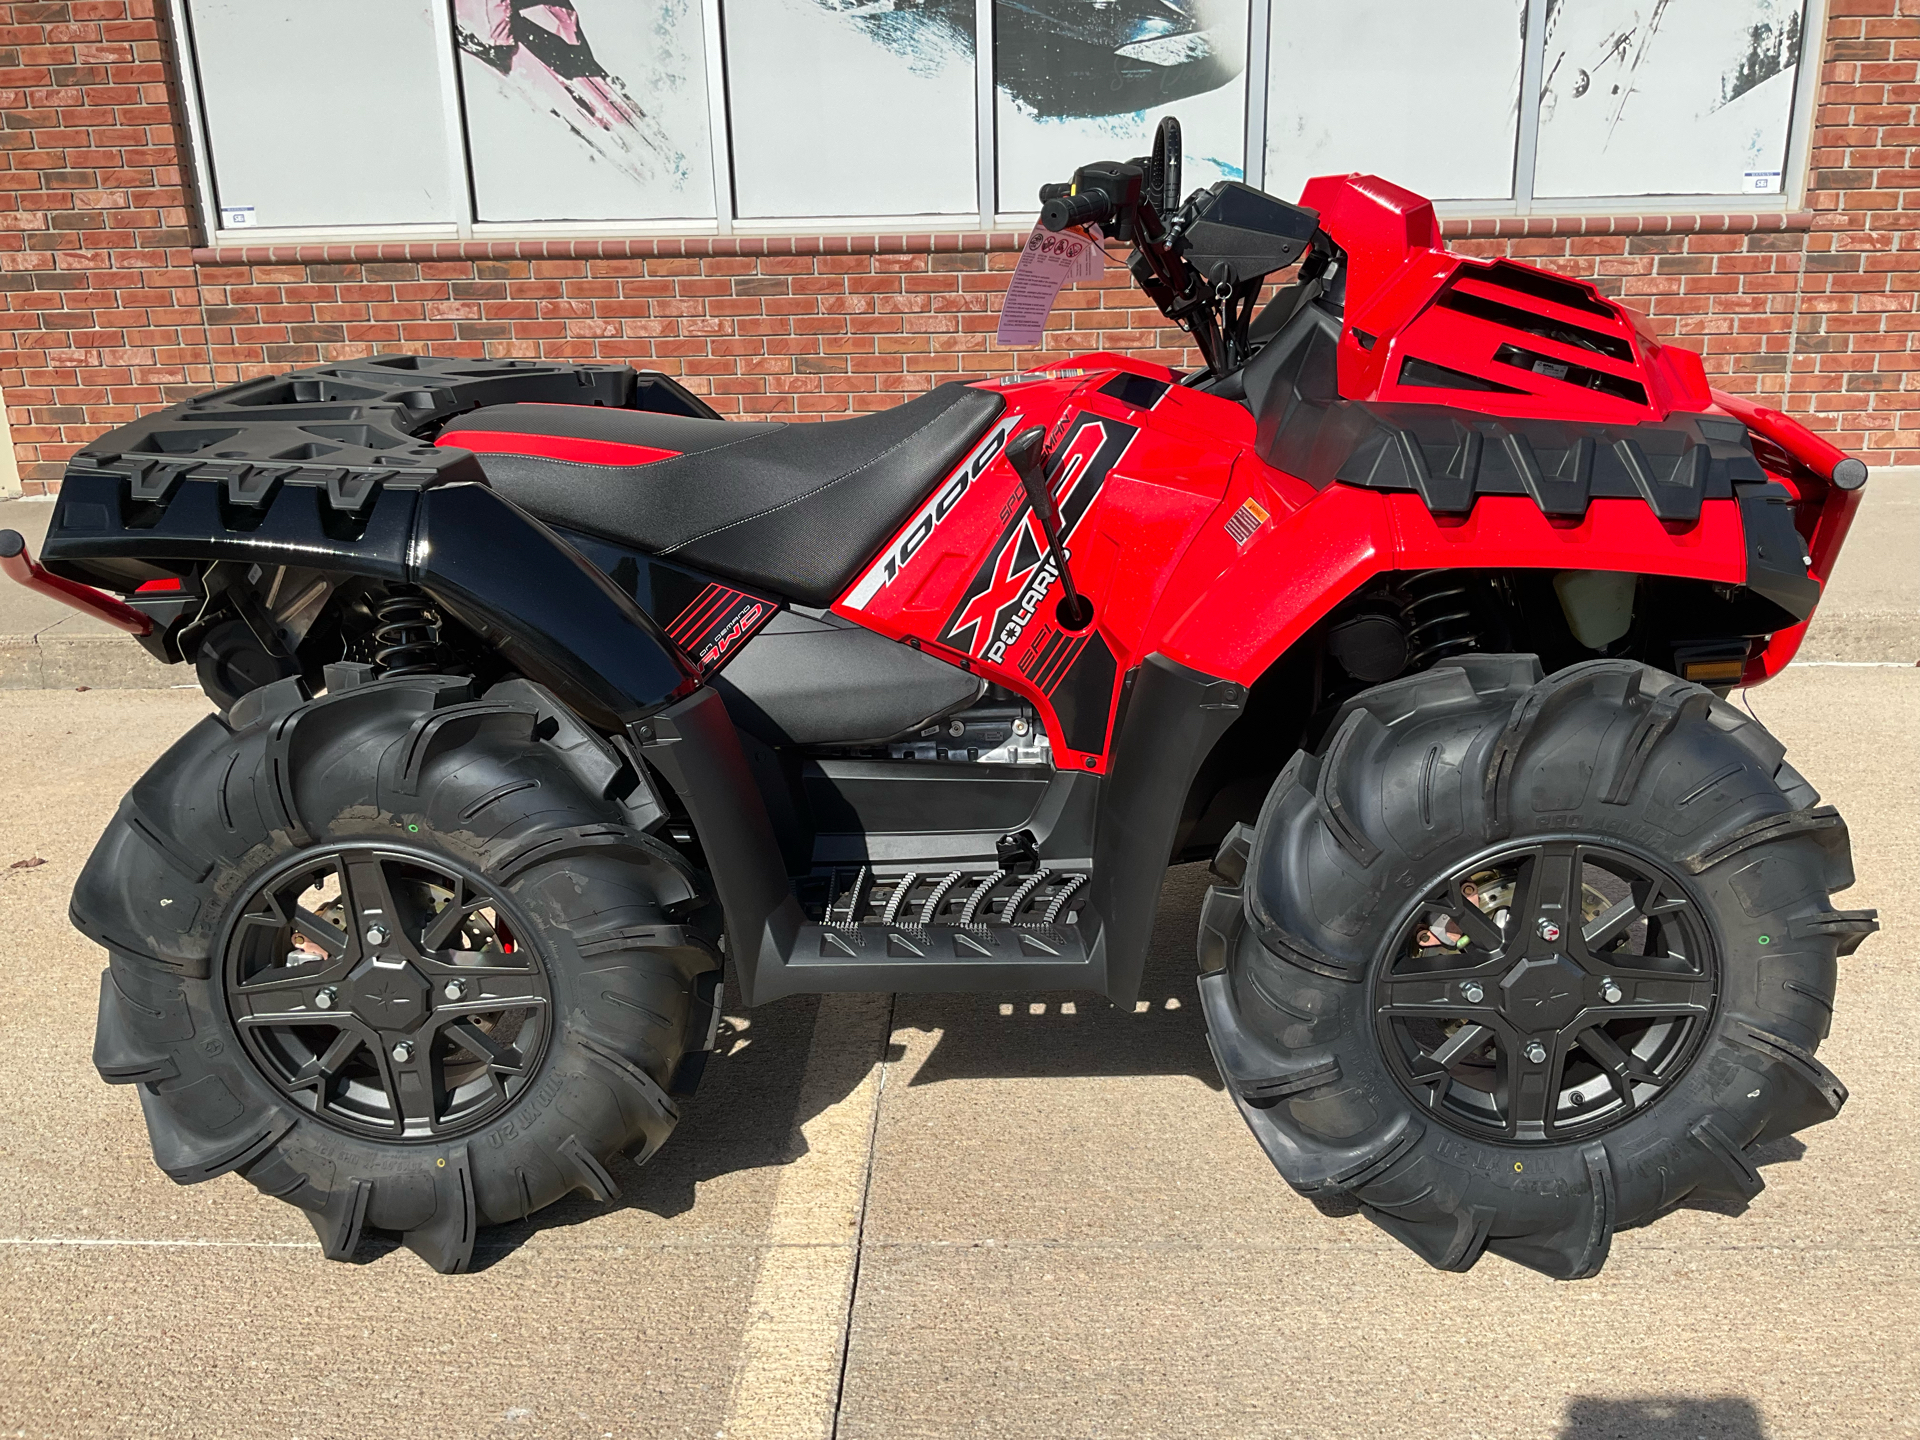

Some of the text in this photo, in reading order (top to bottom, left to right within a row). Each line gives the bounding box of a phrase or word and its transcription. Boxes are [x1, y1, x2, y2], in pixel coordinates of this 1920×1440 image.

[882, 426, 1008, 587] 1000
[696, 602, 763, 674] AWD
[699, 604, 751, 657] ON DEMAND
[1017, 623, 1053, 674] EFI
